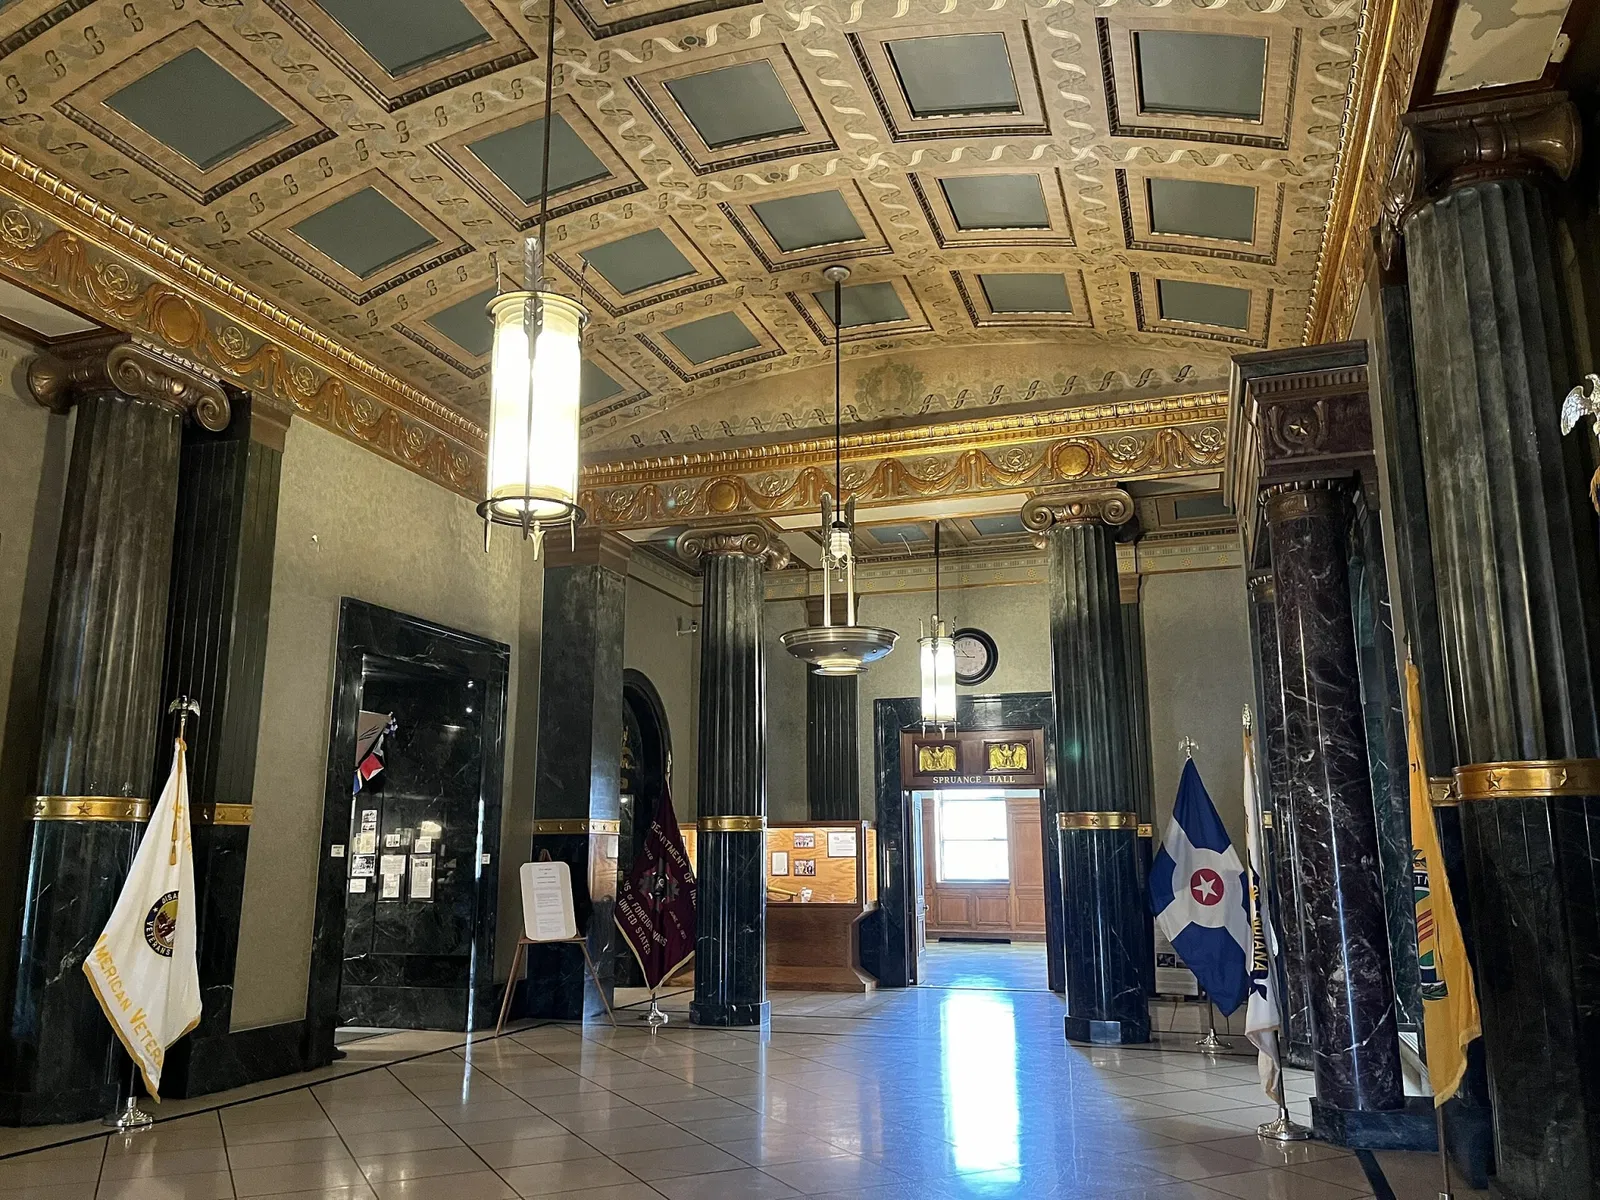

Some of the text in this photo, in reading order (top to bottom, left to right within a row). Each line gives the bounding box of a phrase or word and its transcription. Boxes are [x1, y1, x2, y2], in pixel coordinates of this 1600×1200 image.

[933, 775, 1016, 784] SPRUANCE HALL
[683, 872, 695, 885] OF
[146, 921, 171, 955] VETERANS
[618, 899, 638, 926] UNITED
[635, 926, 651, 955] STATES
